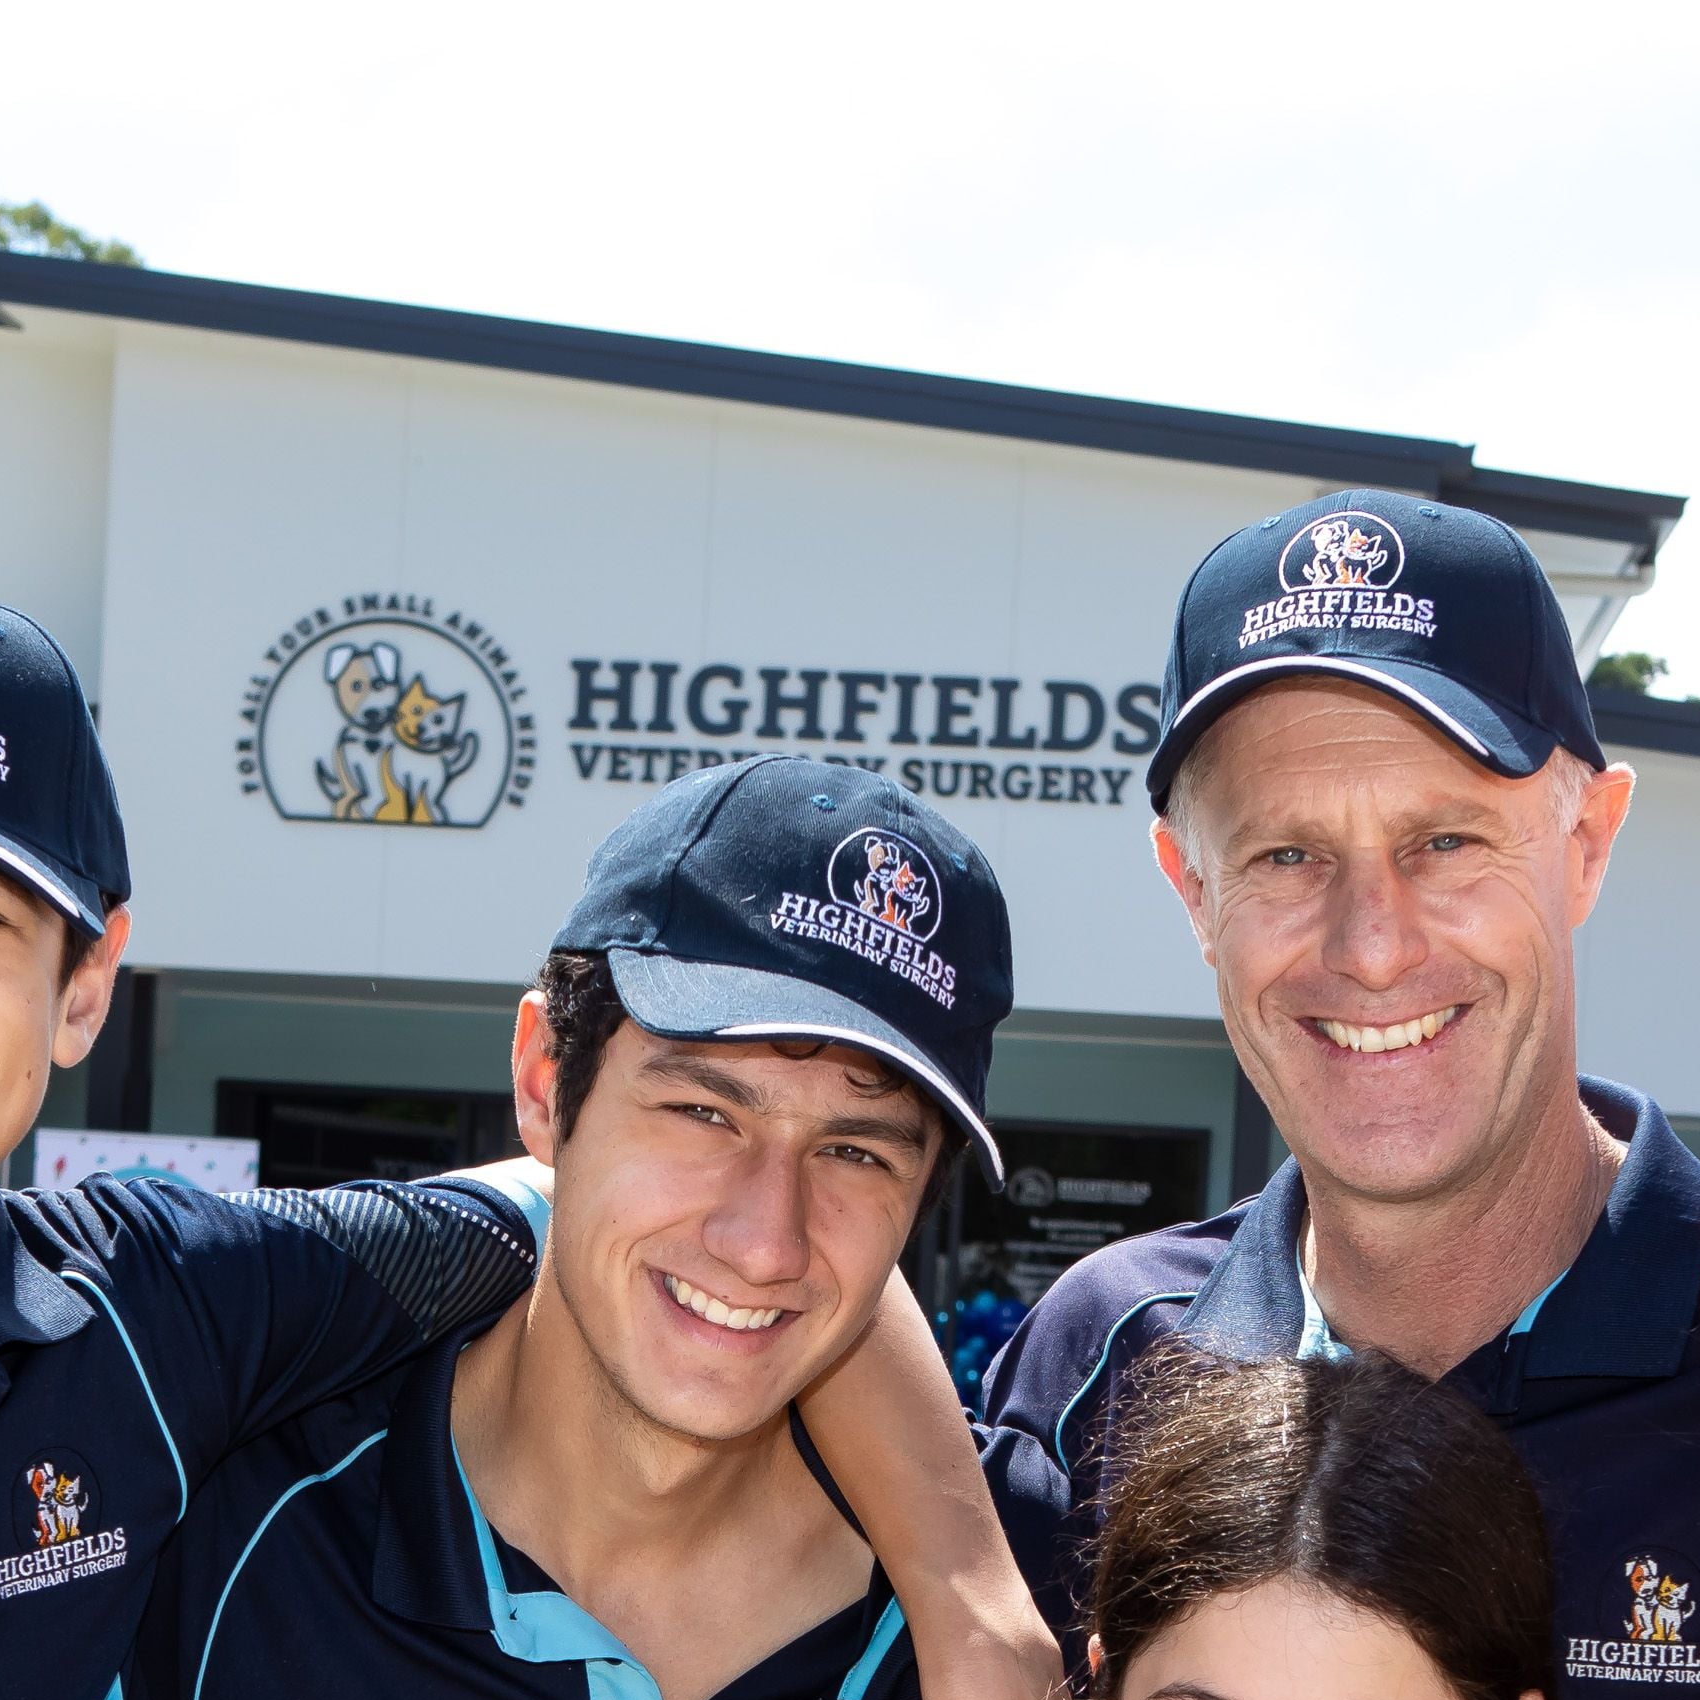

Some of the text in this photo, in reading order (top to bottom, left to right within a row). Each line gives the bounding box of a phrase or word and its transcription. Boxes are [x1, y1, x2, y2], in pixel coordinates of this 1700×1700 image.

[1238, 613, 1438, 650] VETERINARY SURGERY
[1242, 590, 1435, 634] HIGHFIELDS
[236, 593, 537, 806] FOR ALL YOUR SMALL ANIMAL NEEDS
[567, 659, 1161, 755] HIGHFIELDS
[902, 759, 1132, 805] SURGERY
[770, 913, 956, 1010] VETERINARY SURGERY
[777, 892, 956, 990] HIGHFIELDS
[72, 1551, 127, 1579] SURGERY
[1566, 1663, 1663, 1683] VETERINARY
